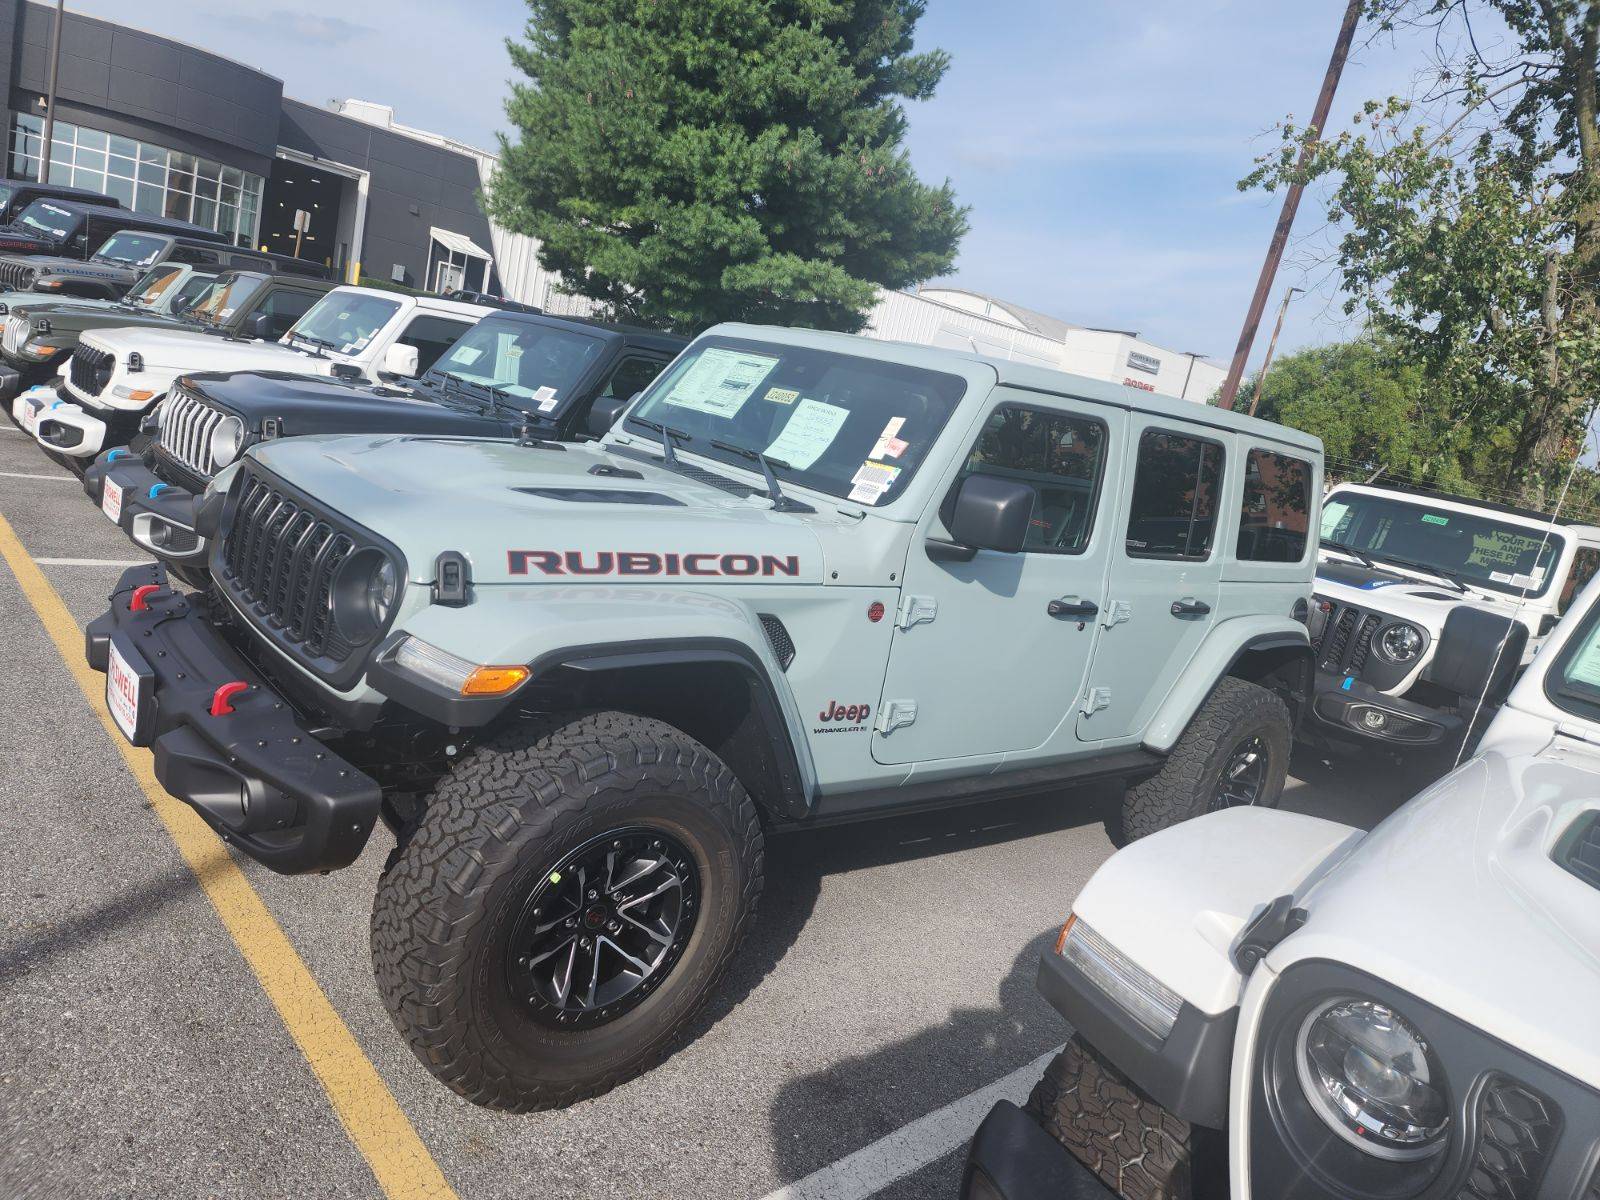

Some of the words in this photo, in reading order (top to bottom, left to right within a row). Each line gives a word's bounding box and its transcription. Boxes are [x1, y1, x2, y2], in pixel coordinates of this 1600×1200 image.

[1124, 377, 1155, 391] DODGE
[507, 550, 799, 577] RUBICON
[820, 700, 870, 724] Jeep
[813, 726, 859, 735] WRANGLER
